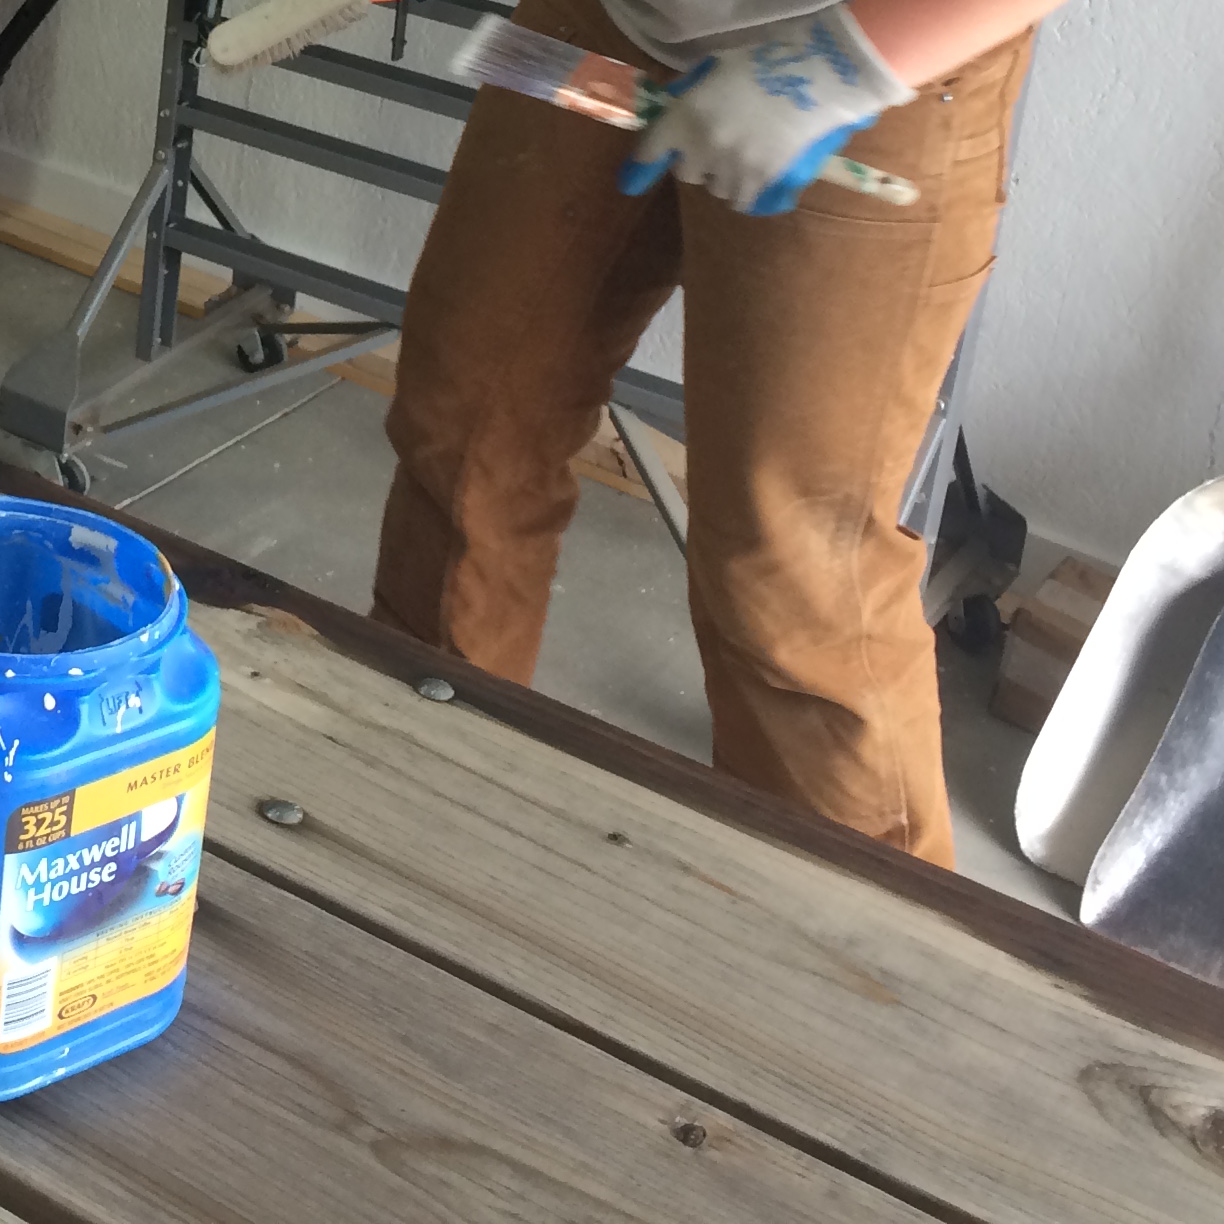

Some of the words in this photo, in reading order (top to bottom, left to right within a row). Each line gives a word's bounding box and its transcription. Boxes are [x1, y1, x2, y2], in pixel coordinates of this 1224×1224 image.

[126, 762, 182, 794] MASTER
[20, 802, 49, 816] MAKES
[49, 798, 61, 809] UP
[61, 795, 71, 805] TO
[18, 805, 68, 840] 325
[35, 836, 47, 846] OZ
[48, 828, 66, 843] CUPS
[14, 820, 137, 891] Maxwell
[26, 861, 118, 912] House
